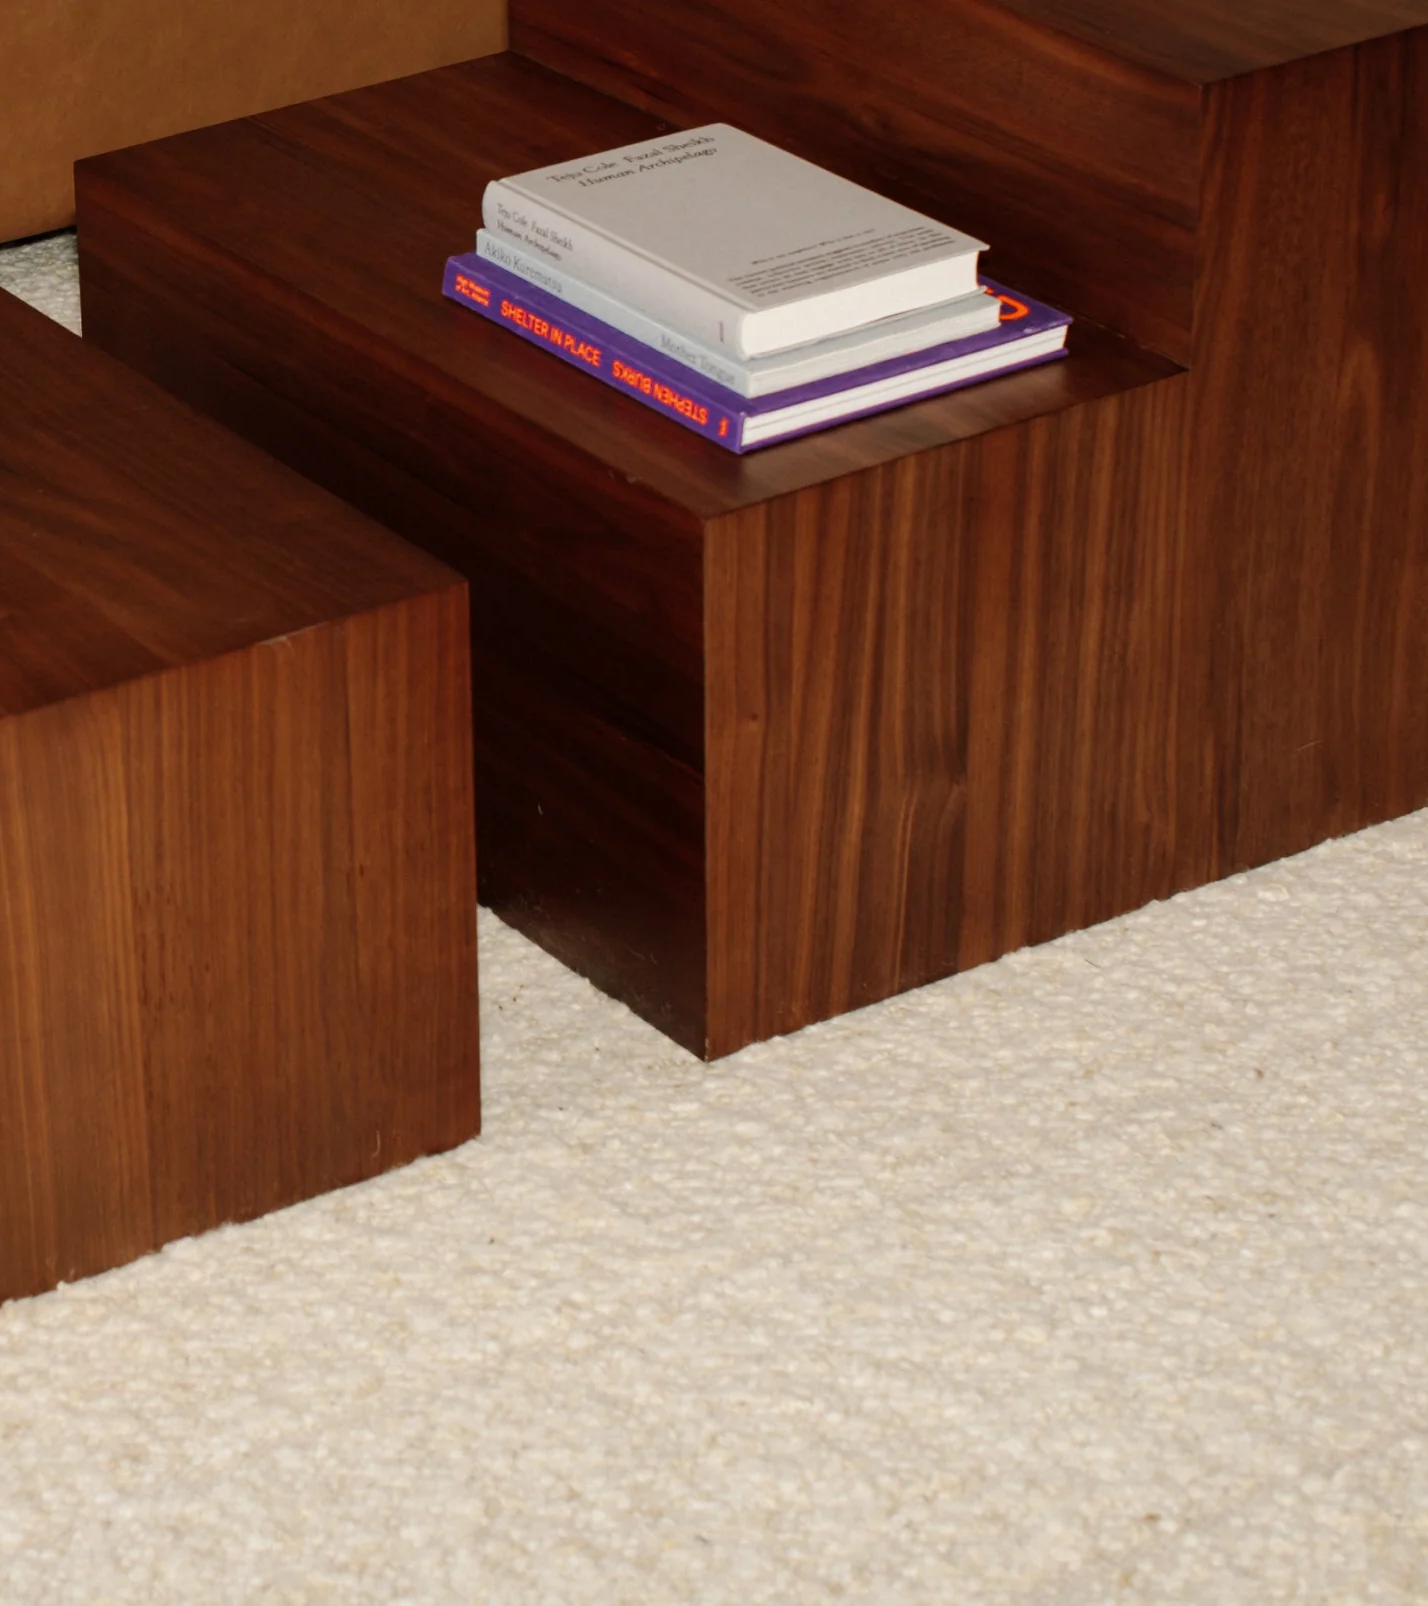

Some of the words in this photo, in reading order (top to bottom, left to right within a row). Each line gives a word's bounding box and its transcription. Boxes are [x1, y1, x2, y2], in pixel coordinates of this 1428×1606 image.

[546, 172, 583, 184] Teju
[583, 160, 618, 174] Cole
[623, 148, 663, 163] Fazal
[662, 136, 715, 154] Sheikh
[578, 169, 635, 187] Human
[639, 147, 717, 173] Archipelago
[500, 299, 550, 339] SHELTER
[550, 325, 564, 345] IN
[563, 333, 603, 368] PLACE
[612, 359, 653, 395] BURKS
[653, 382, 709, 426] STEPHEN
